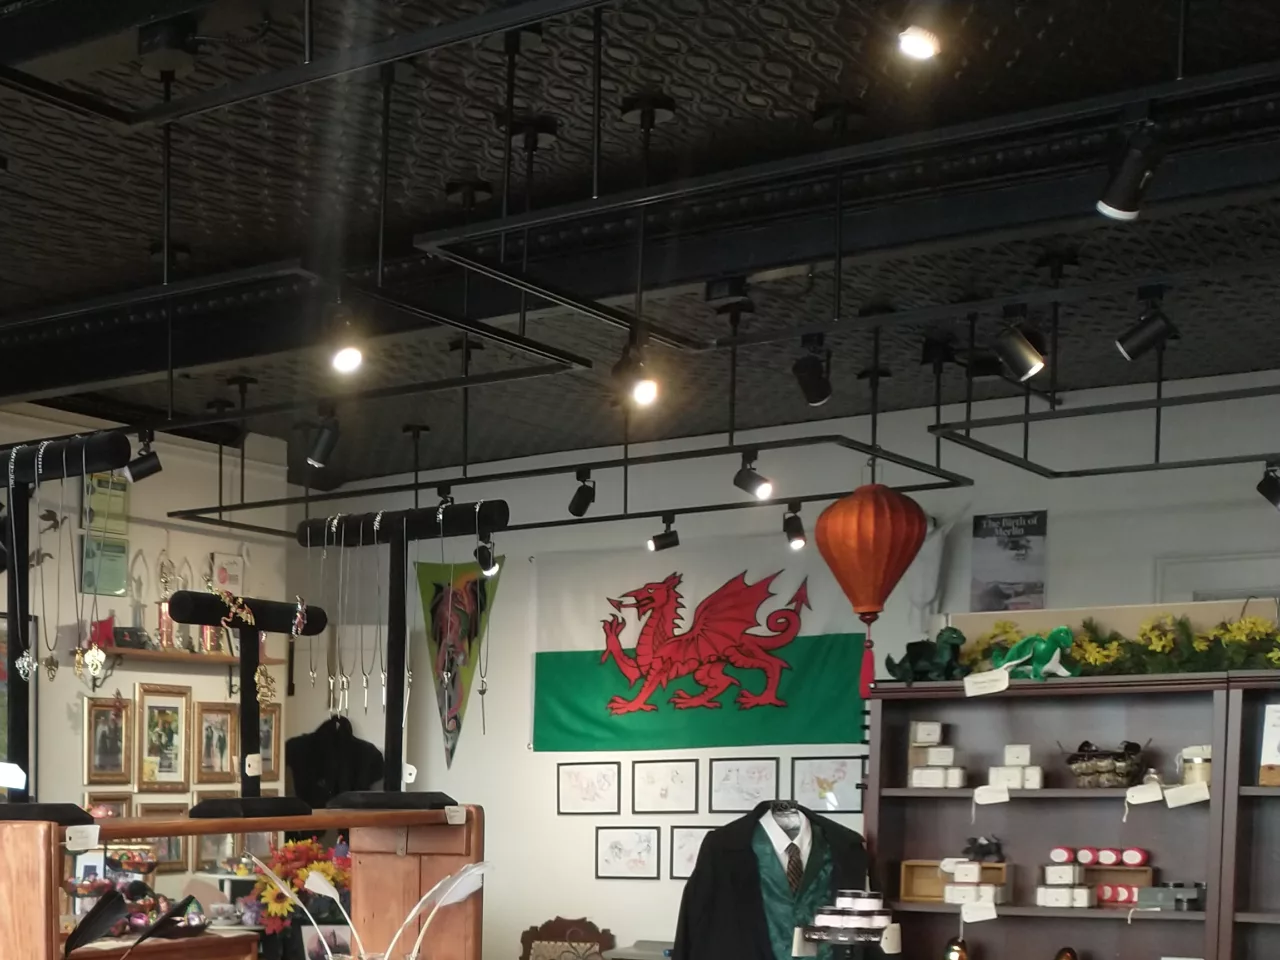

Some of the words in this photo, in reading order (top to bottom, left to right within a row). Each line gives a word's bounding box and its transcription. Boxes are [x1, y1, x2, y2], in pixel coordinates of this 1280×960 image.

[981, 519, 1001, 529] The
[1002, 516, 1026, 528] Birth
[1027, 515, 1039, 525] of
[995, 527, 1025, 536] Merlin
